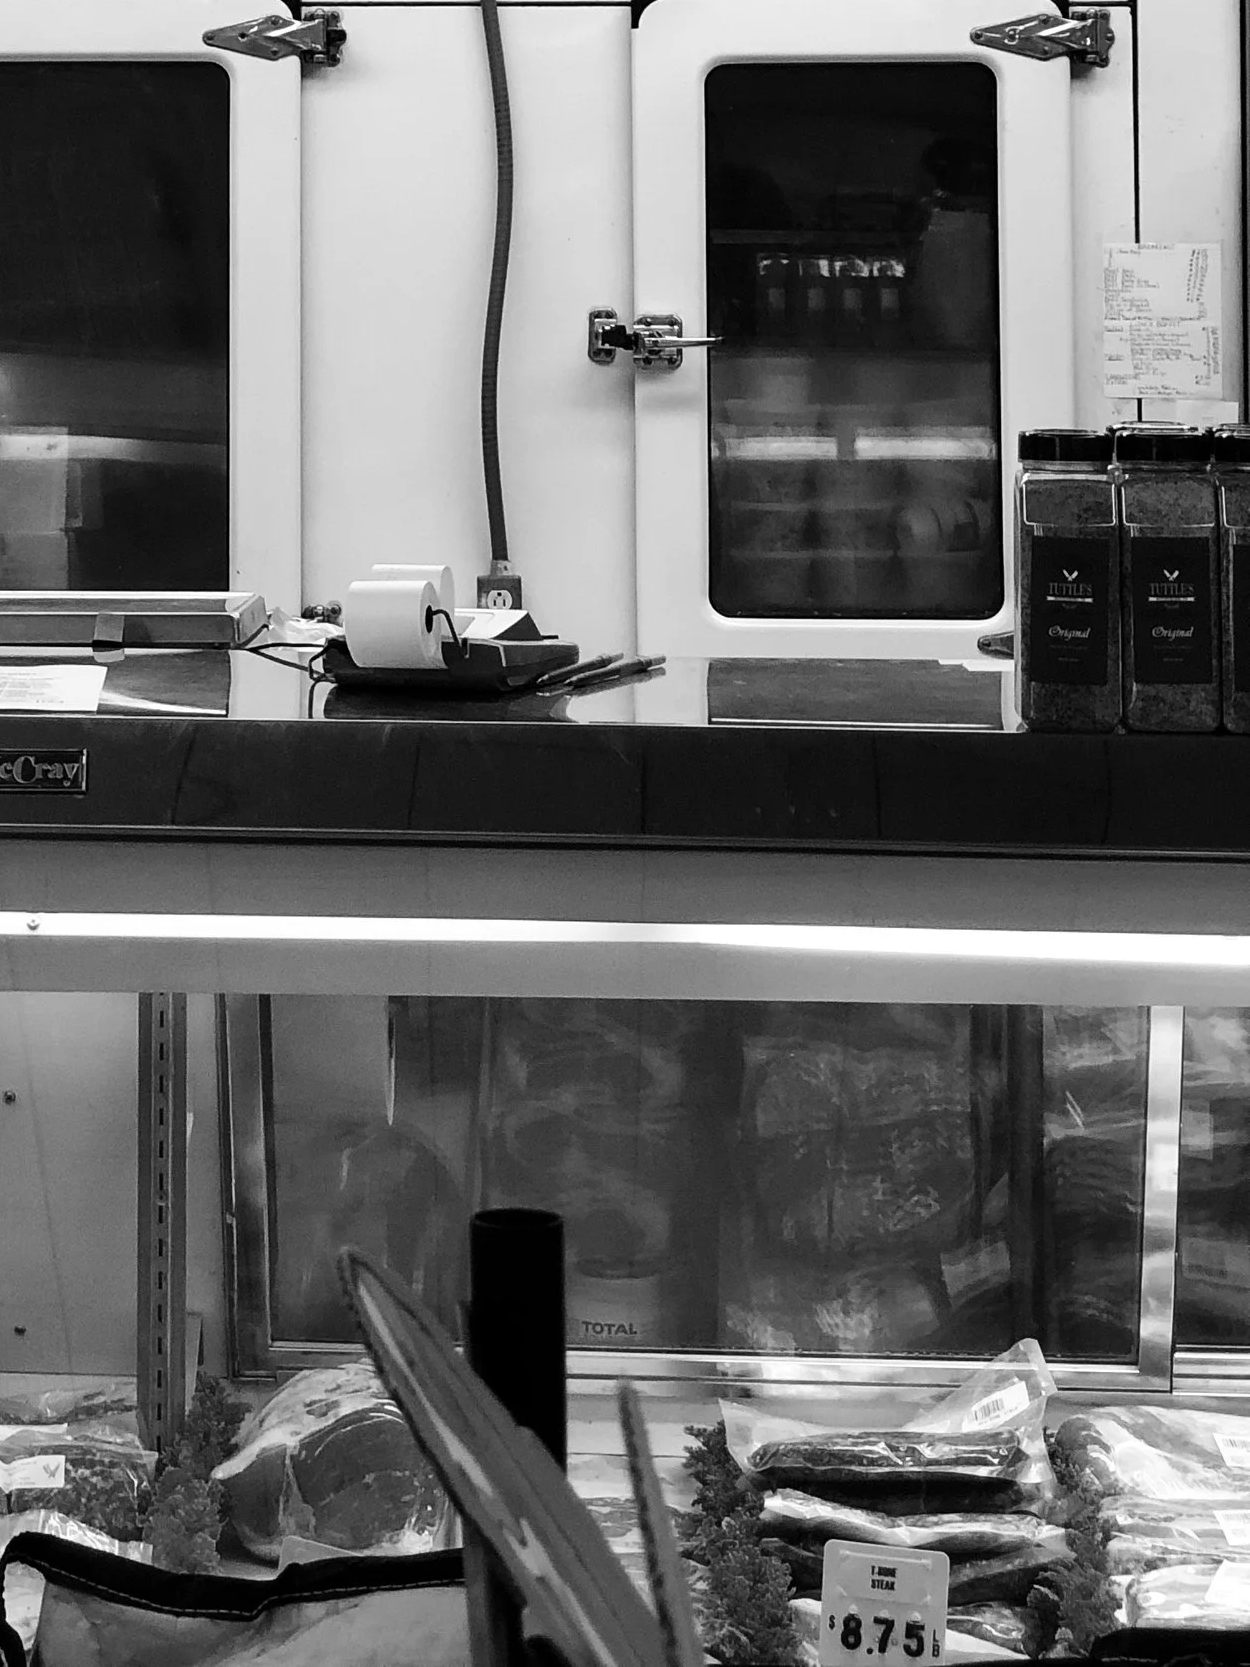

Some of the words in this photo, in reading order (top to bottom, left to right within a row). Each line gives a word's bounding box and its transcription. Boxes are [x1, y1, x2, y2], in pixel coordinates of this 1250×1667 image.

[1049, 625, 1091, 641] Original
[1152, 626, 1194, 641] Original
[582, 1321, 638, 1335] TOTAL
[871, 1579, 896, 1591] STEAK
